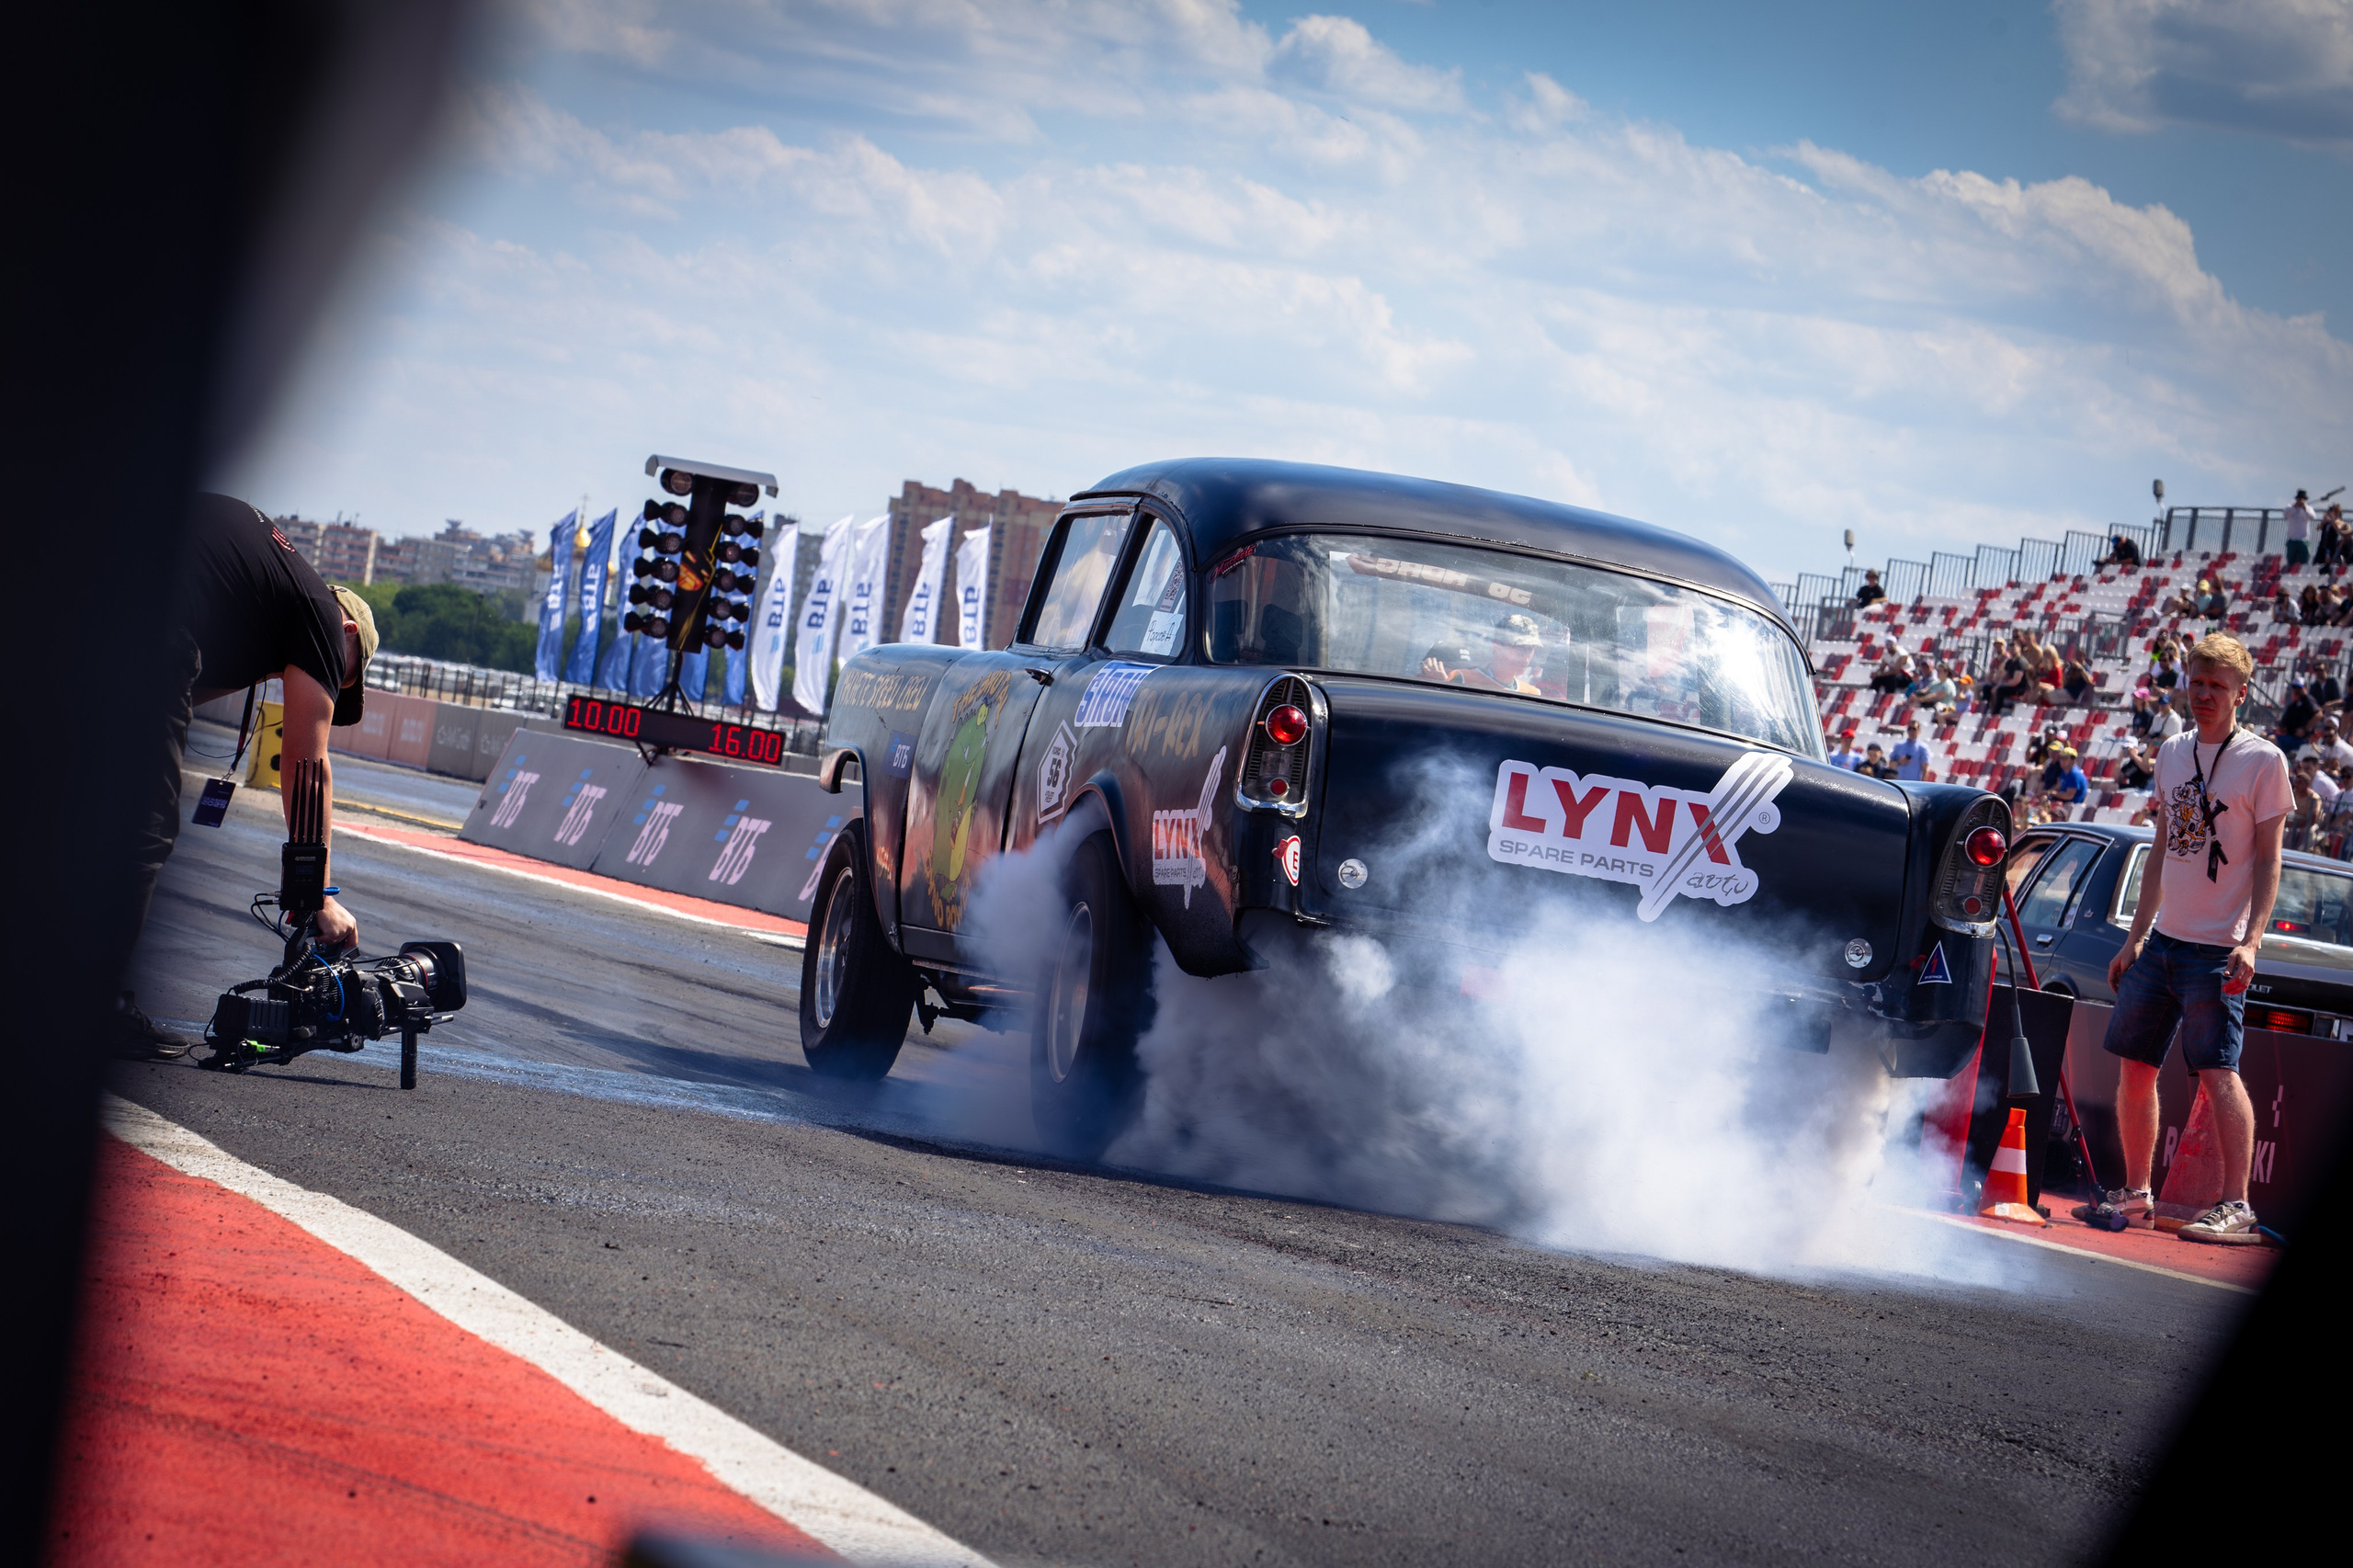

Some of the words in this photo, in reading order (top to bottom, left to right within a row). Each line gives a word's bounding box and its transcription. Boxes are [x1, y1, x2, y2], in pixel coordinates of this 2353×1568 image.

[867, 672, 904, 710] SPEED
[895, 675, 932, 712] CREW
[951, 676, 983, 723] THE
[567, 699, 641, 737] 10.00
[709, 723, 781, 763] 16.00
[892, 744, 910, 769] ВТБ
[1046, 757, 1062, 788] 56
[490, 770, 540, 828] ВТБ
[553, 784, 608, 846] ВТБ
[1502, 761, 1760, 873] LYNX
[625, 801, 684, 867] ВТБ
[709, 816, 772, 886] ВТБ
[1154, 816, 1202, 860] LYNX
[1292, 850, 1299, 870] E
[1499, 839, 1574, 864] SPARE
[1581, 853, 1654, 878] PARTS
[1686, 870, 1749, 897] auto
